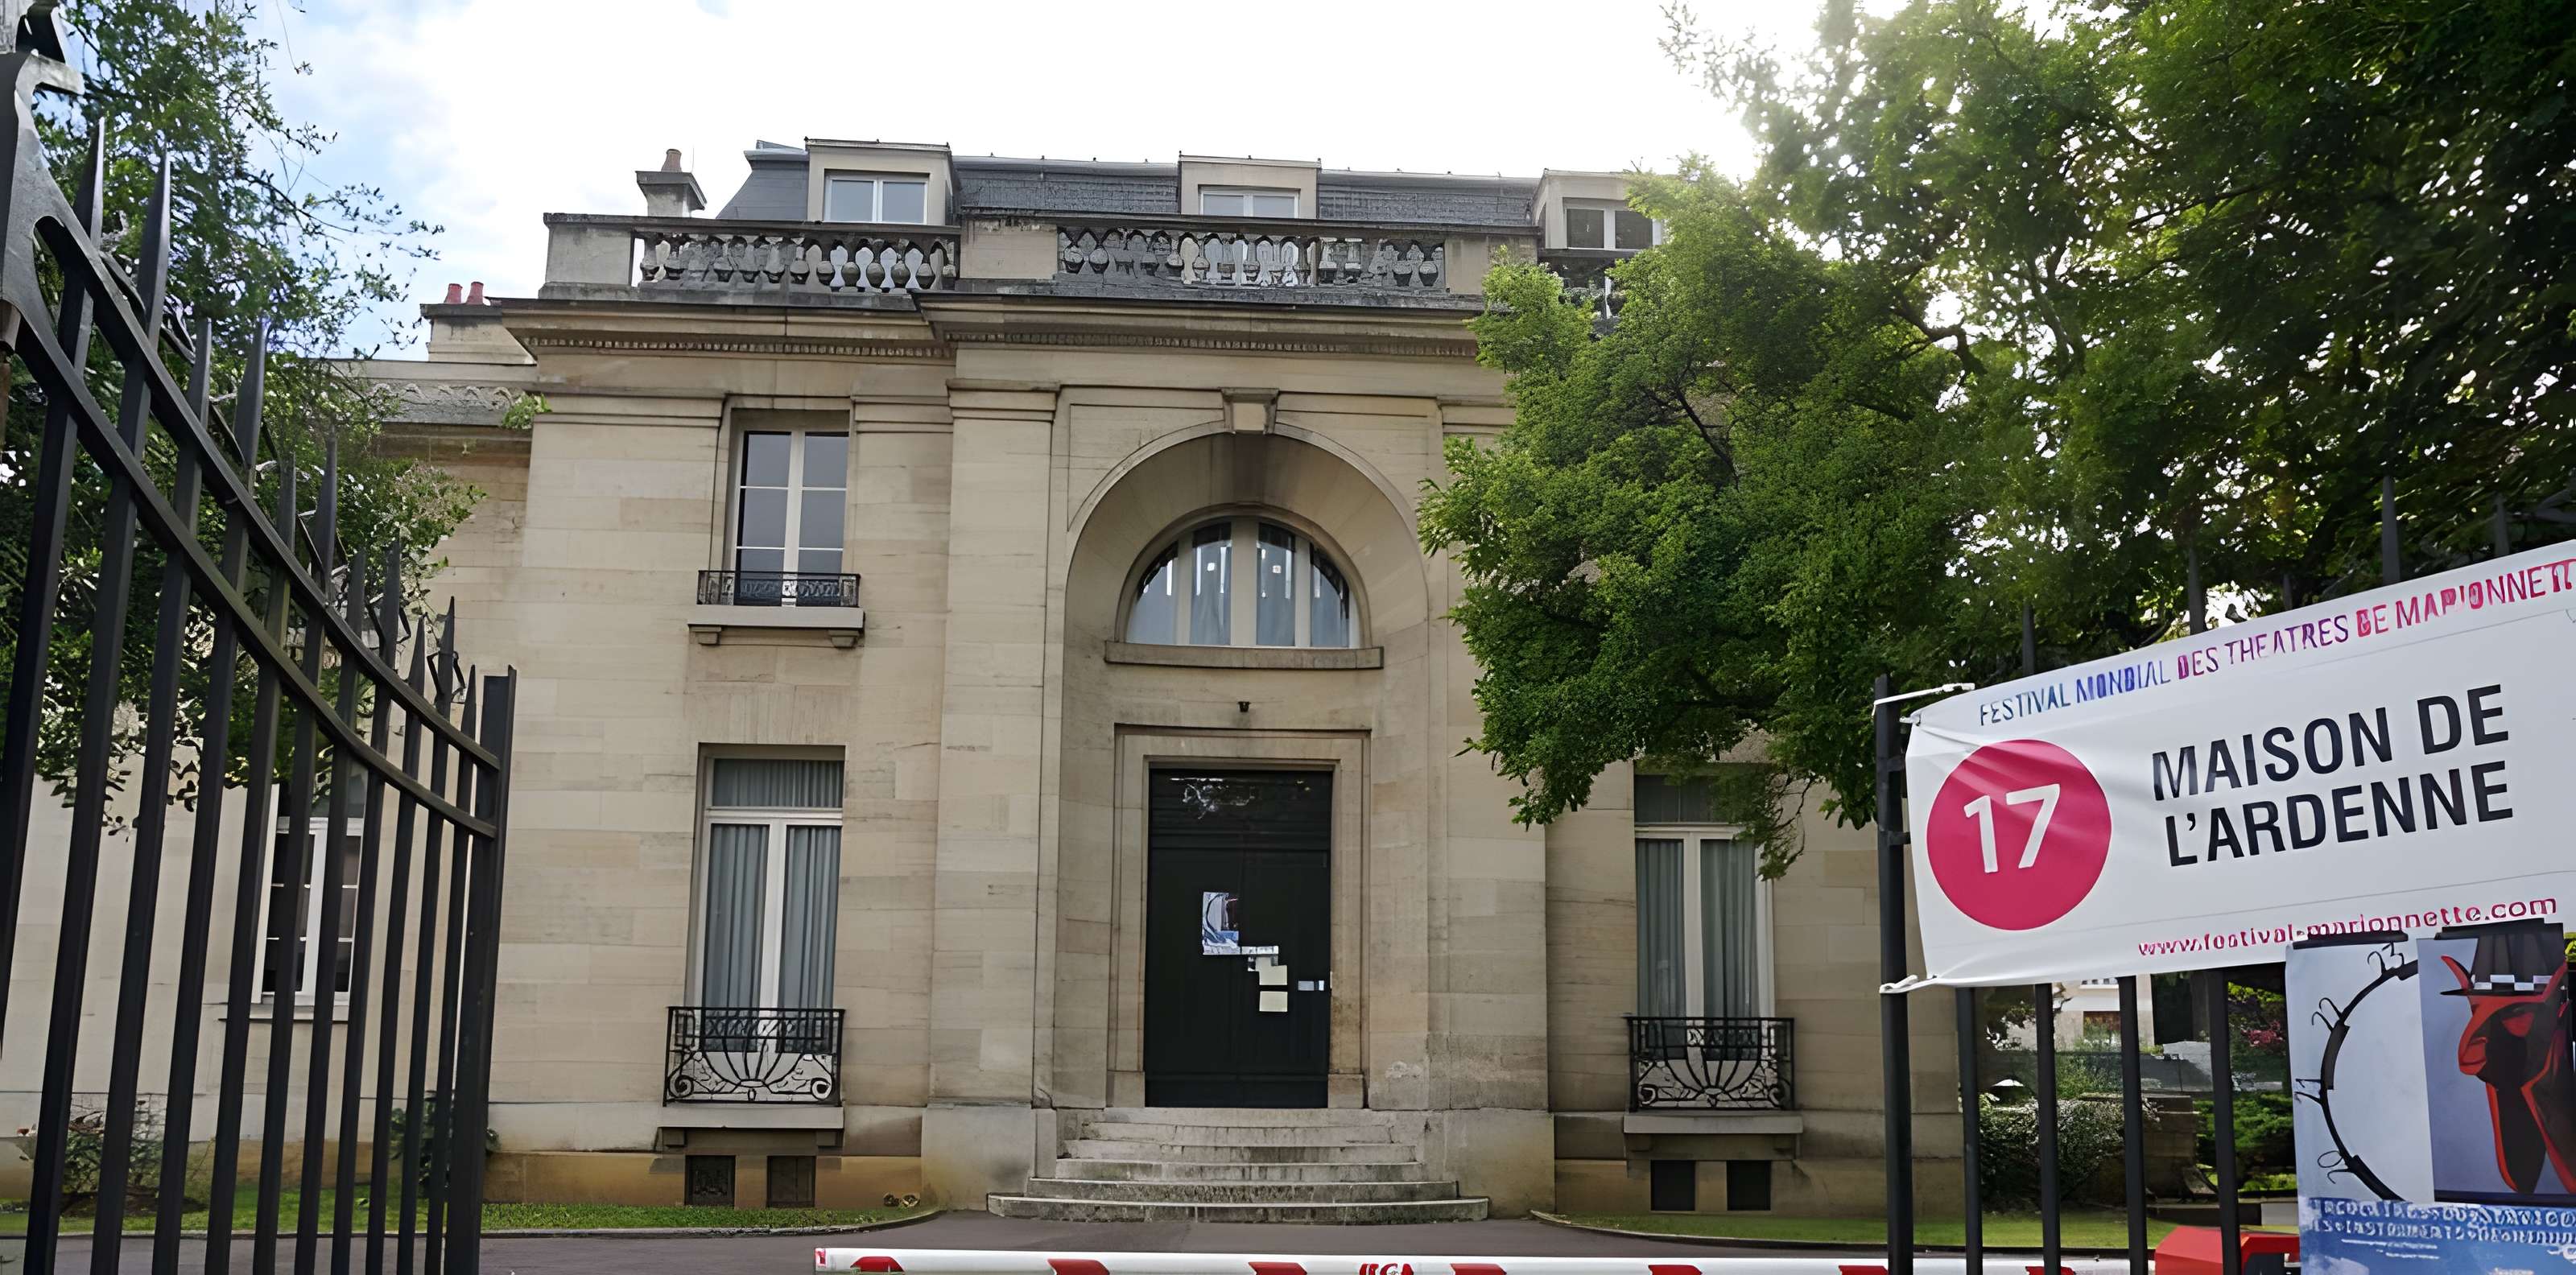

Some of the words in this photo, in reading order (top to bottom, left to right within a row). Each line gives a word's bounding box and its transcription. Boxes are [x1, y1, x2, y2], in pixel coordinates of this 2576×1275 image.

[1979, 683, 2071, 726] FESTIVAL
[2076, 660, 2171, 704] MONDIAL
[2178, 646, 2219, 679] DES
[2224, 614, 2349, 665] THEATRES
[2355, 604, 2389, 638] DE
[2152, 707, 2393, 801] MAISON
[2417, 683, 2509, 755] DE
[1963, 783, 2061, 873] 17
[2165, 760, 2513, 867] L'ARDENNE
